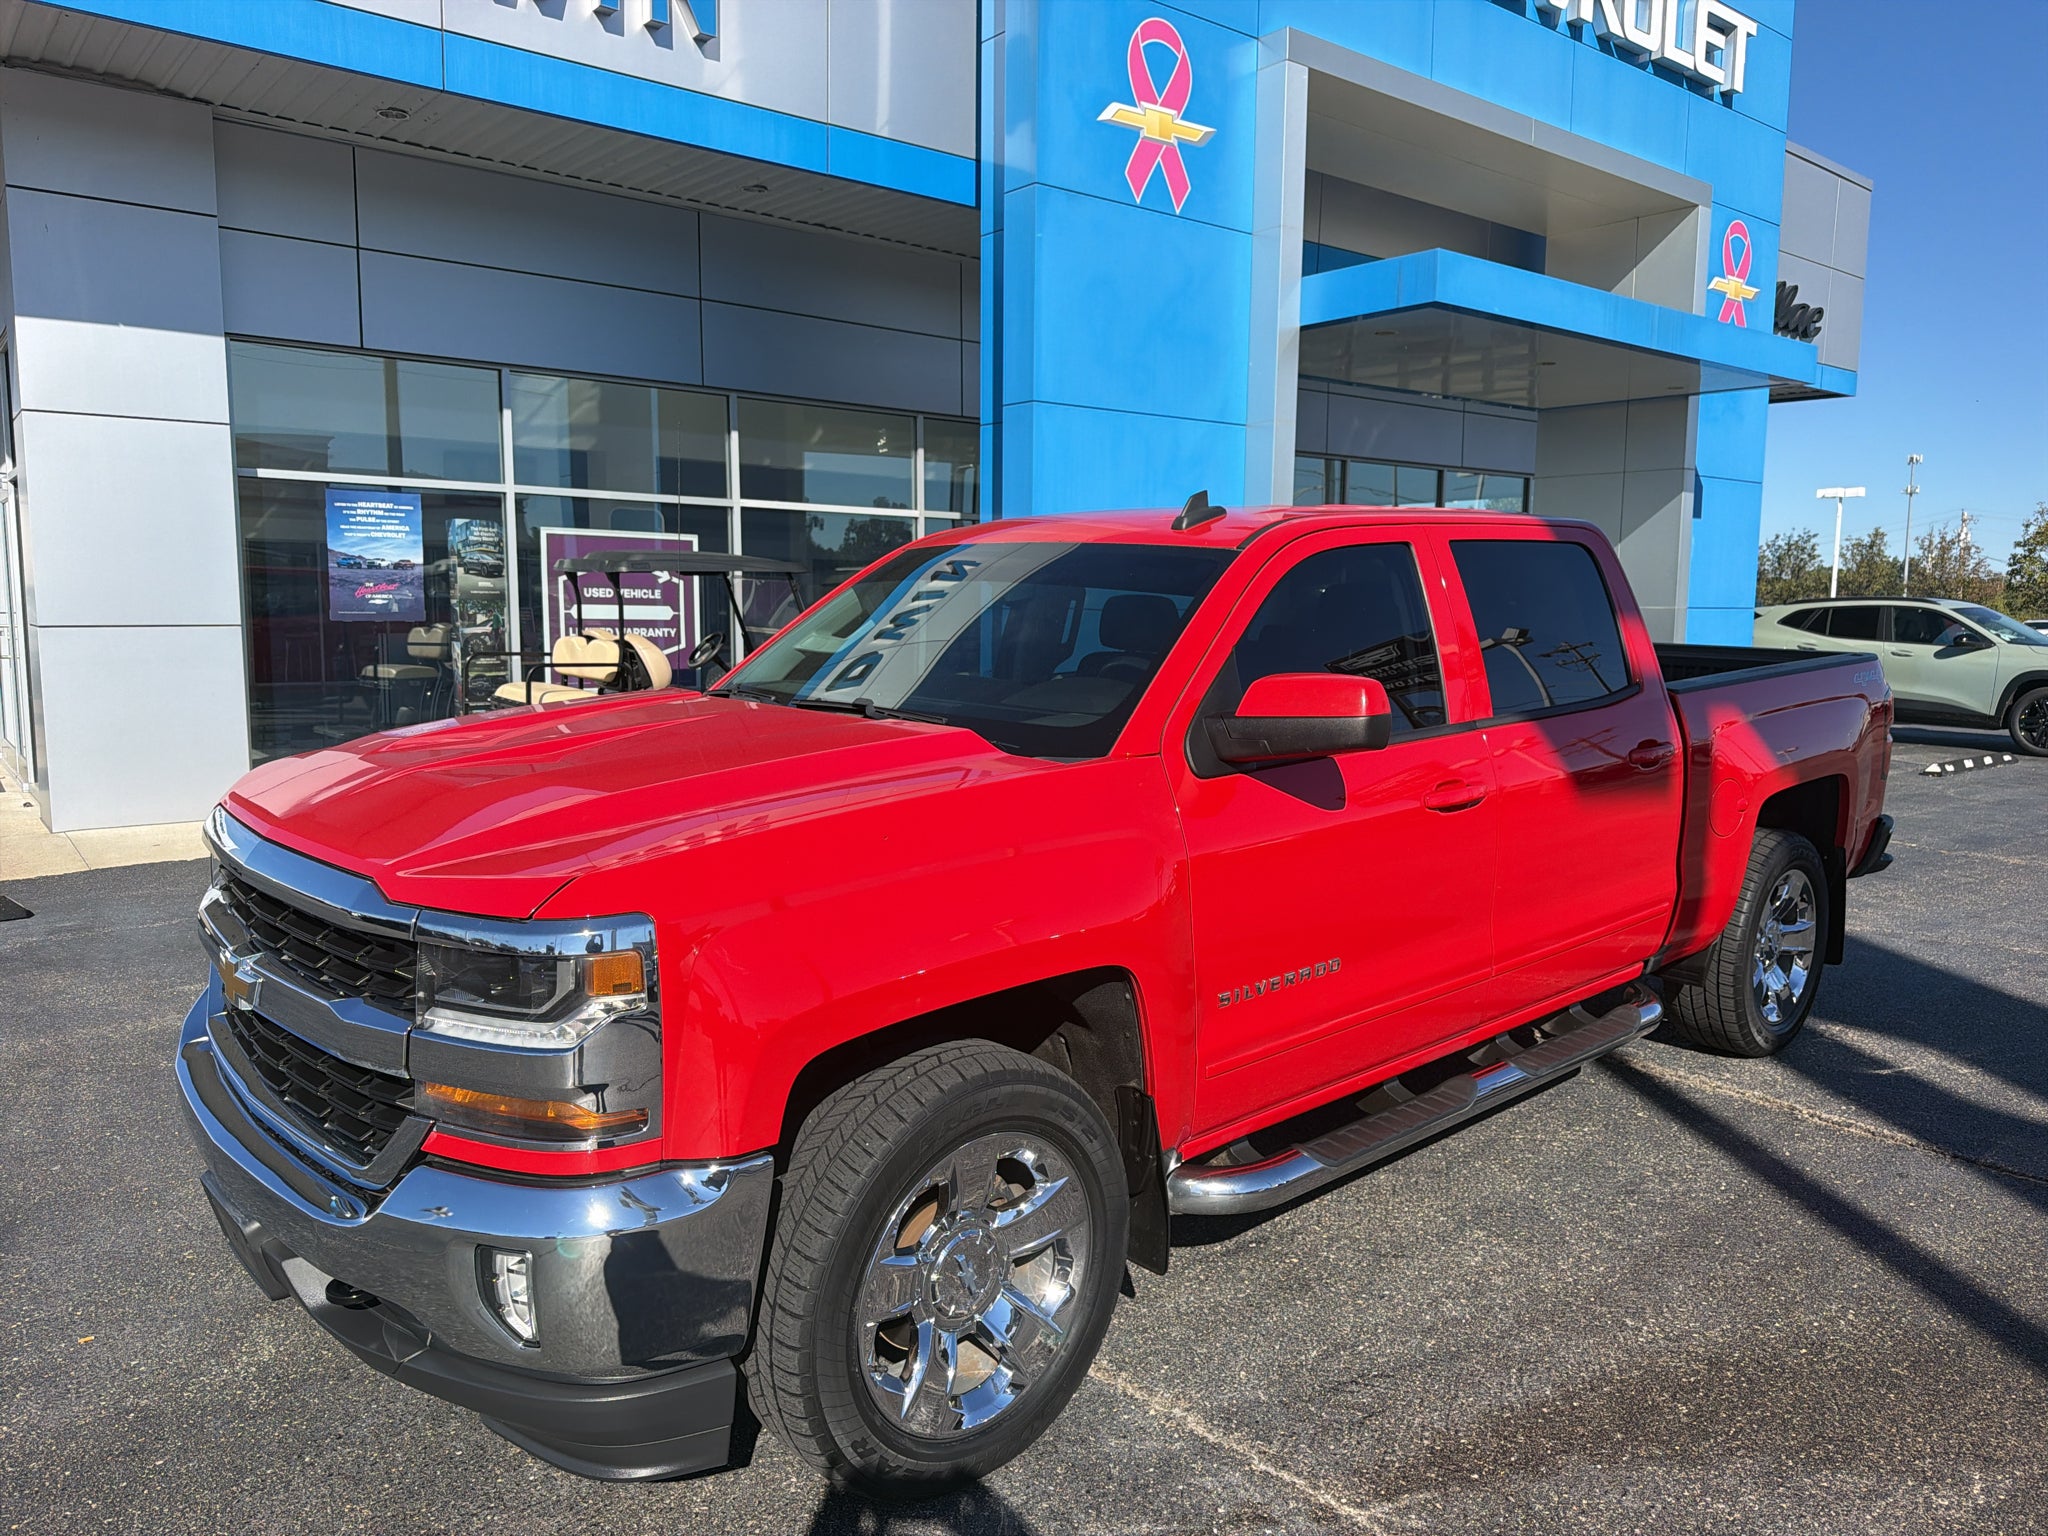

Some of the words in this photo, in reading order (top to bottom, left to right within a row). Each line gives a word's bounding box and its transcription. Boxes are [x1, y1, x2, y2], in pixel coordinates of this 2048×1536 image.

[357, 501, 394, 509] HEARTBEAT
[381, 524, 410, 532] AMERICA
[370, 531, 406, 539] CHEVROLET
[583, 587, 614, 598] USED
[1217, 957, 1342, 1009] SILVERADO
